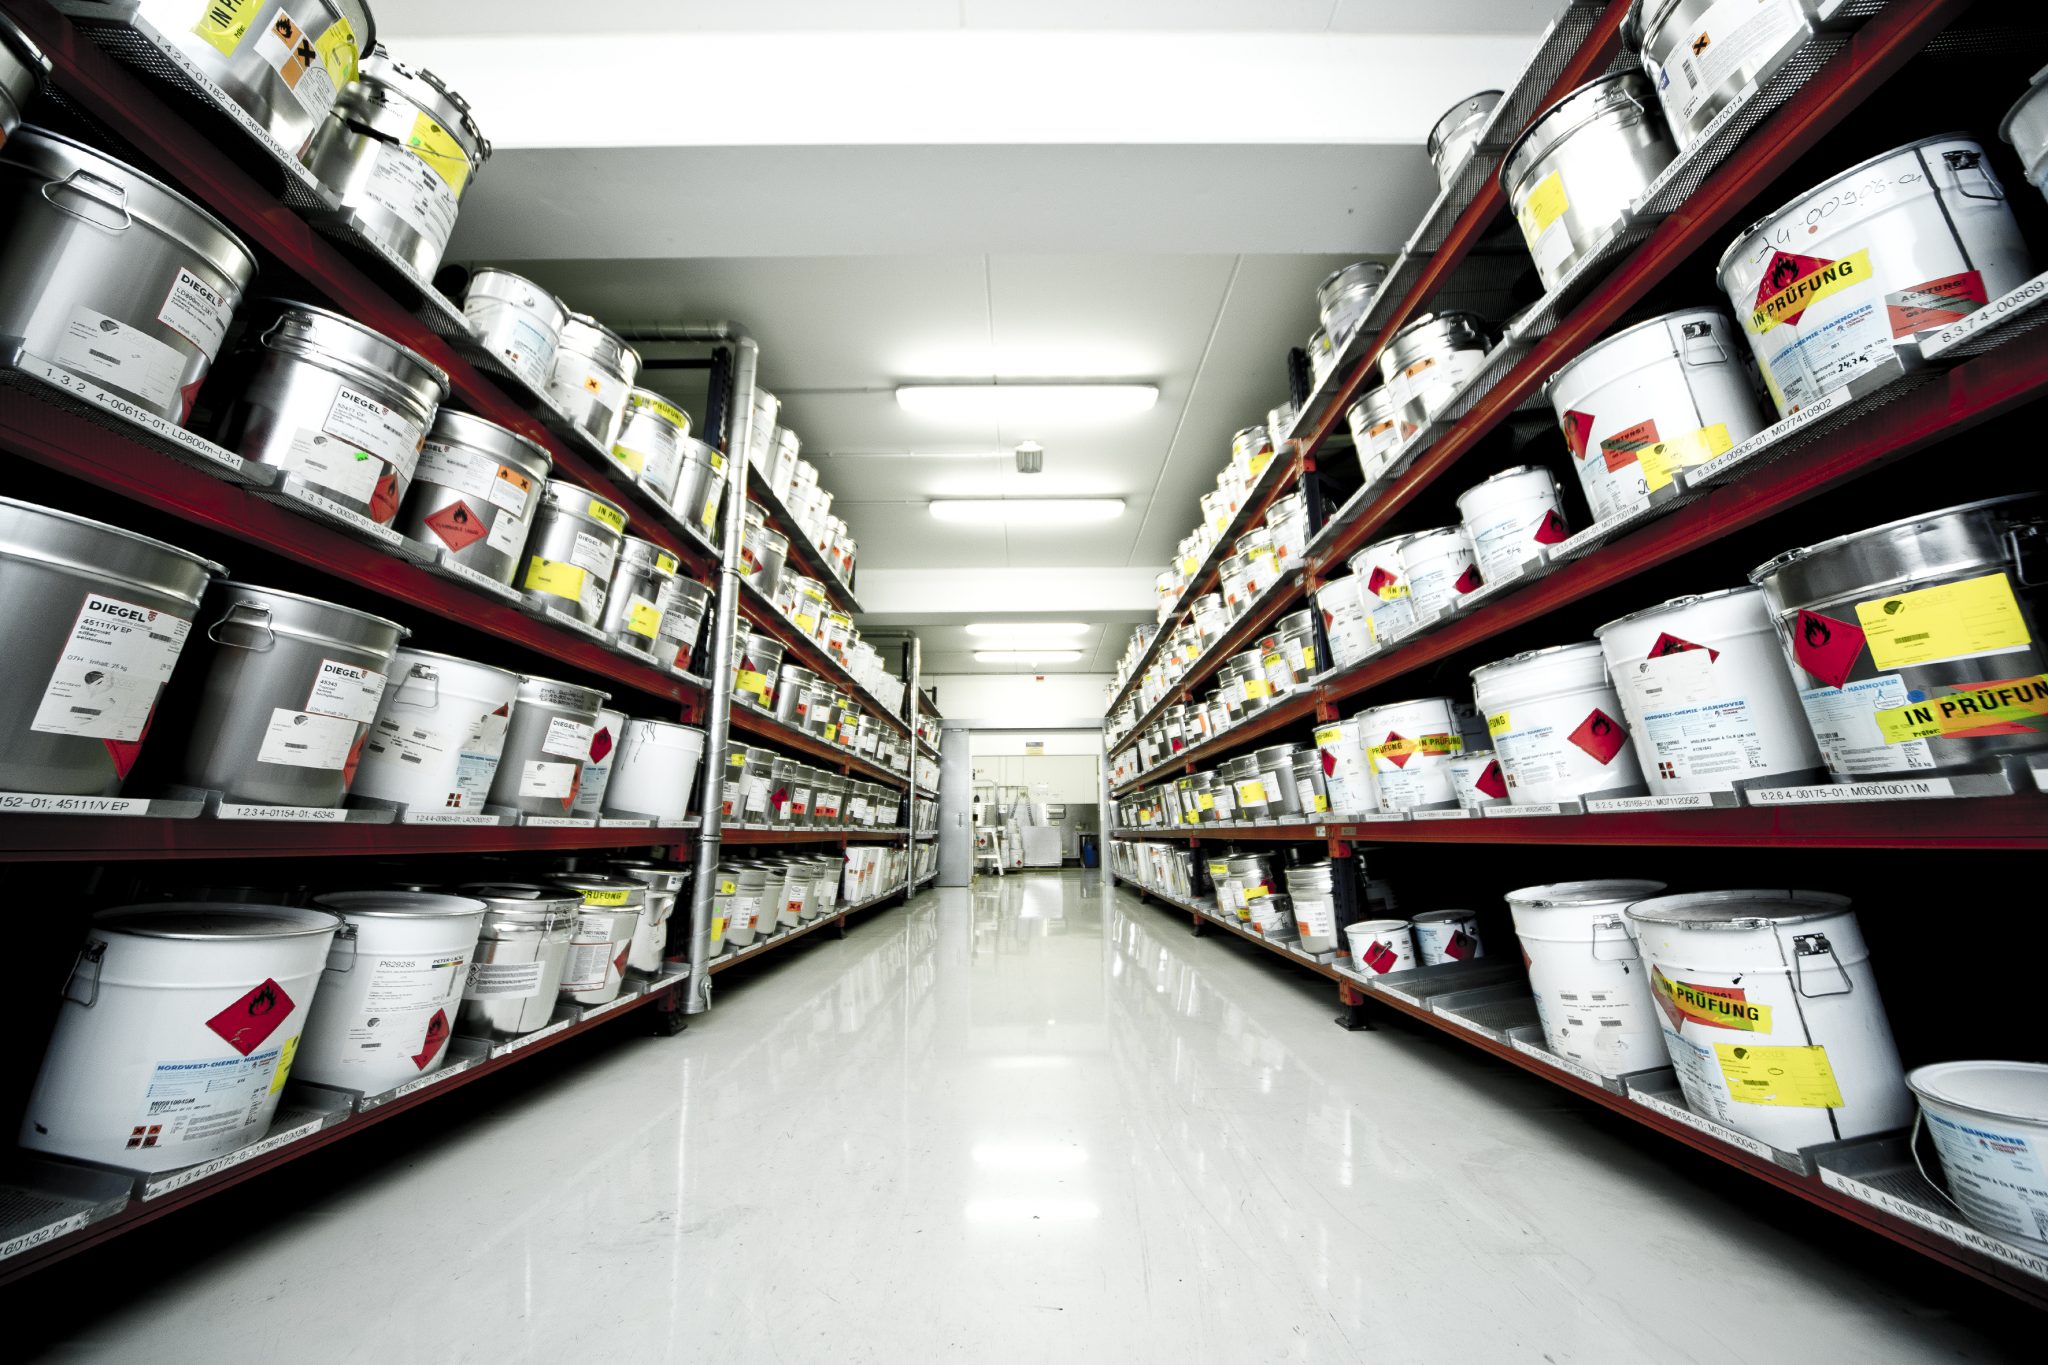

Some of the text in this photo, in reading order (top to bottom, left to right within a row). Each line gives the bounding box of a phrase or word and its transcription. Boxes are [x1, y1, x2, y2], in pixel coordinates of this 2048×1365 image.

[180, 273, 218, 305] DIEGEL
[1753, 260, 1854, 327] IN PRÜFUNG
[1900, 278, 1967, 301] ACHTUNG!
[1821, 303, 1872, 331] HANNOVER
[1940, 317, 1977, 343] 8.3.7
[340, 389, 381, 414] DIEGEL
[1771, 397, 1832, 436] M077410902
[578, 533, 600, 548] DIEGEL
[88, 600, 146, 622] DIEGEL
[82, 618, 118, 631] 45111/V
[324, 664, 361, 679] DIEGEL
[1847, 678, 1897, 692] HANNOVER
[1702, 700, 1744, 711] HANNOVER
[1905, 706, 1934, 726] IN
[553, 720, 575, 729] DIEGEL
[1429, 736, 1461, 746] PRÜFUNG
[1851, 782, 1930, 796] M06010011M
[56, 798, 107, 810] 45111/V
[111, 801, 129, 810] EP
[236, 807, 257, 816] 1.2.3
[312, 810, 335, 818] 45345
[1676, 985, 1760, 1022] PRÜFUNG
[157, 1058, 240, 1071] NORDWEST-CHEMIE
